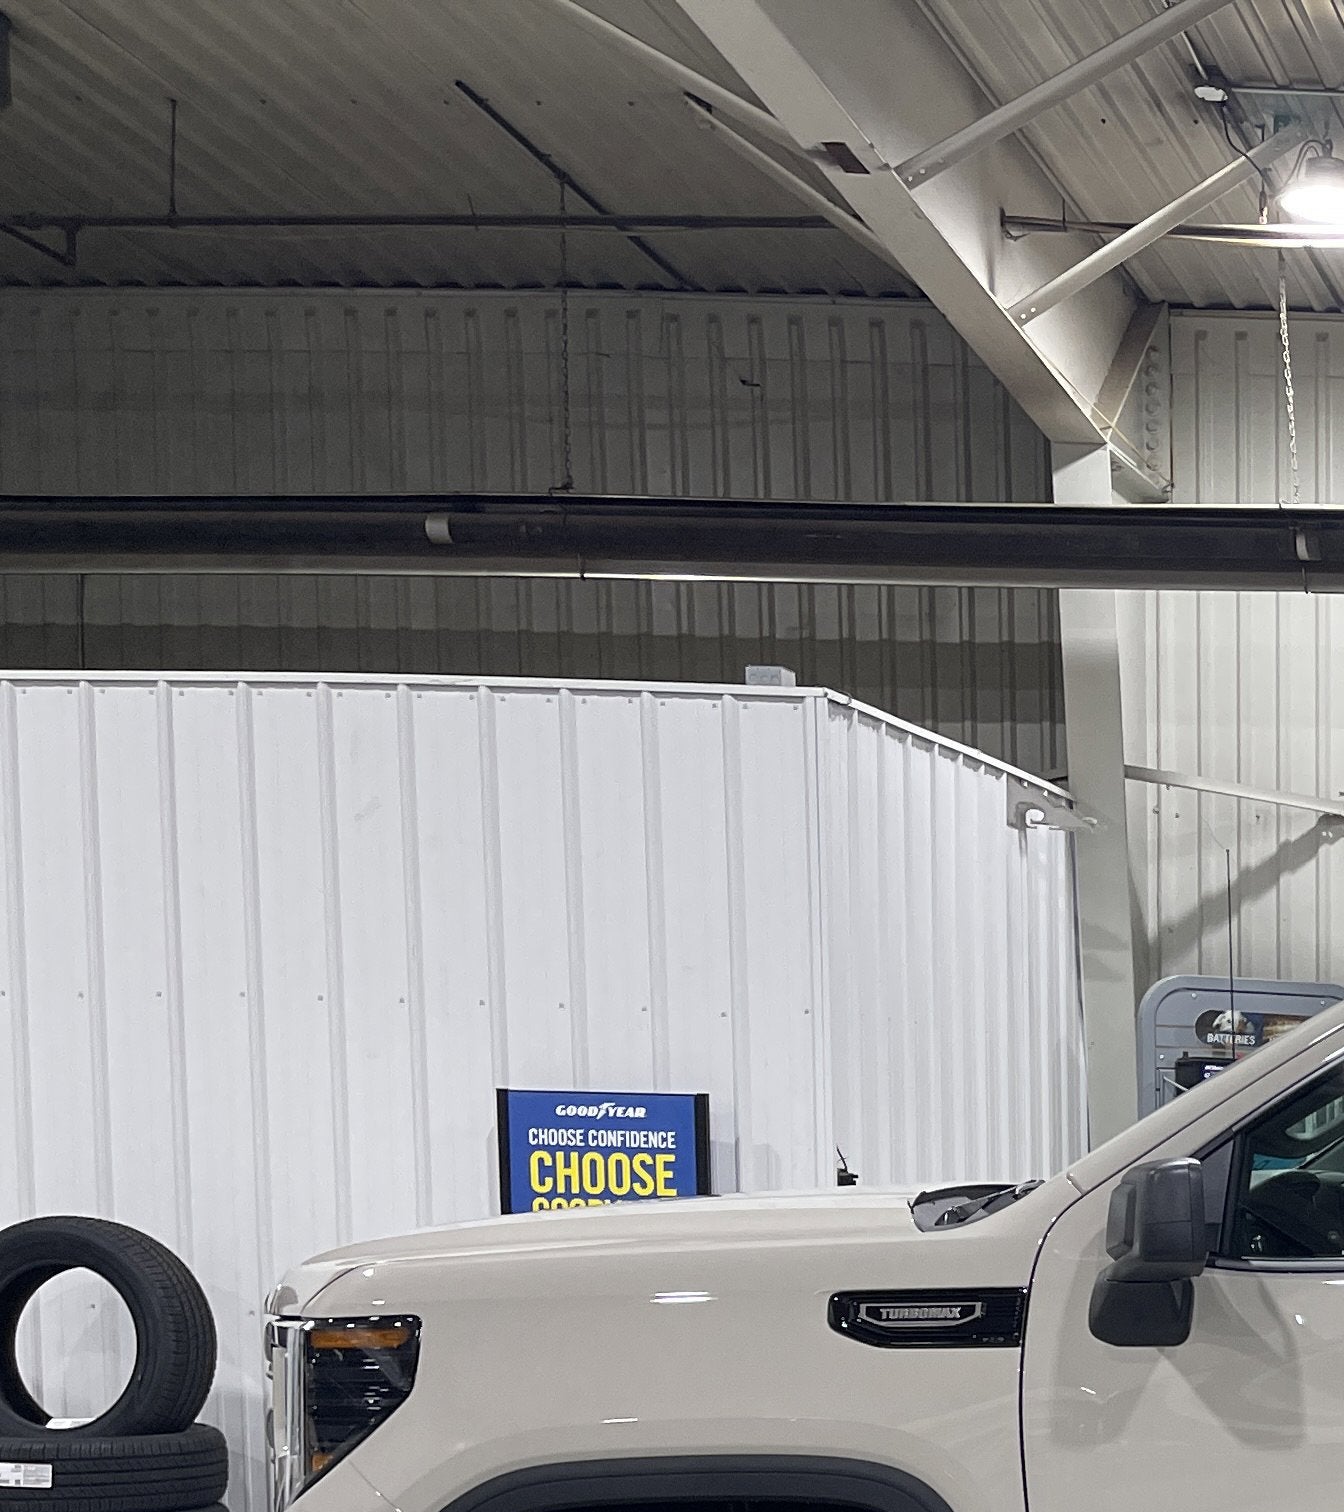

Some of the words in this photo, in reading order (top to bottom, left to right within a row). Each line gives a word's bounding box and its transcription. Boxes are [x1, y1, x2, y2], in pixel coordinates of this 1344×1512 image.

[1206, 1033, 1256, 1046] BATTERIES
[555, 1102, 647, 1120] GOODYEAR
[528, 1128, 585, 1147] CHOOSE
[588, 1129, 676, 1149] CONFIDENCE
[529, 1150, 677, 1197] CHOOSE
[879, 1306, 961, 1319] TURBOMAX
